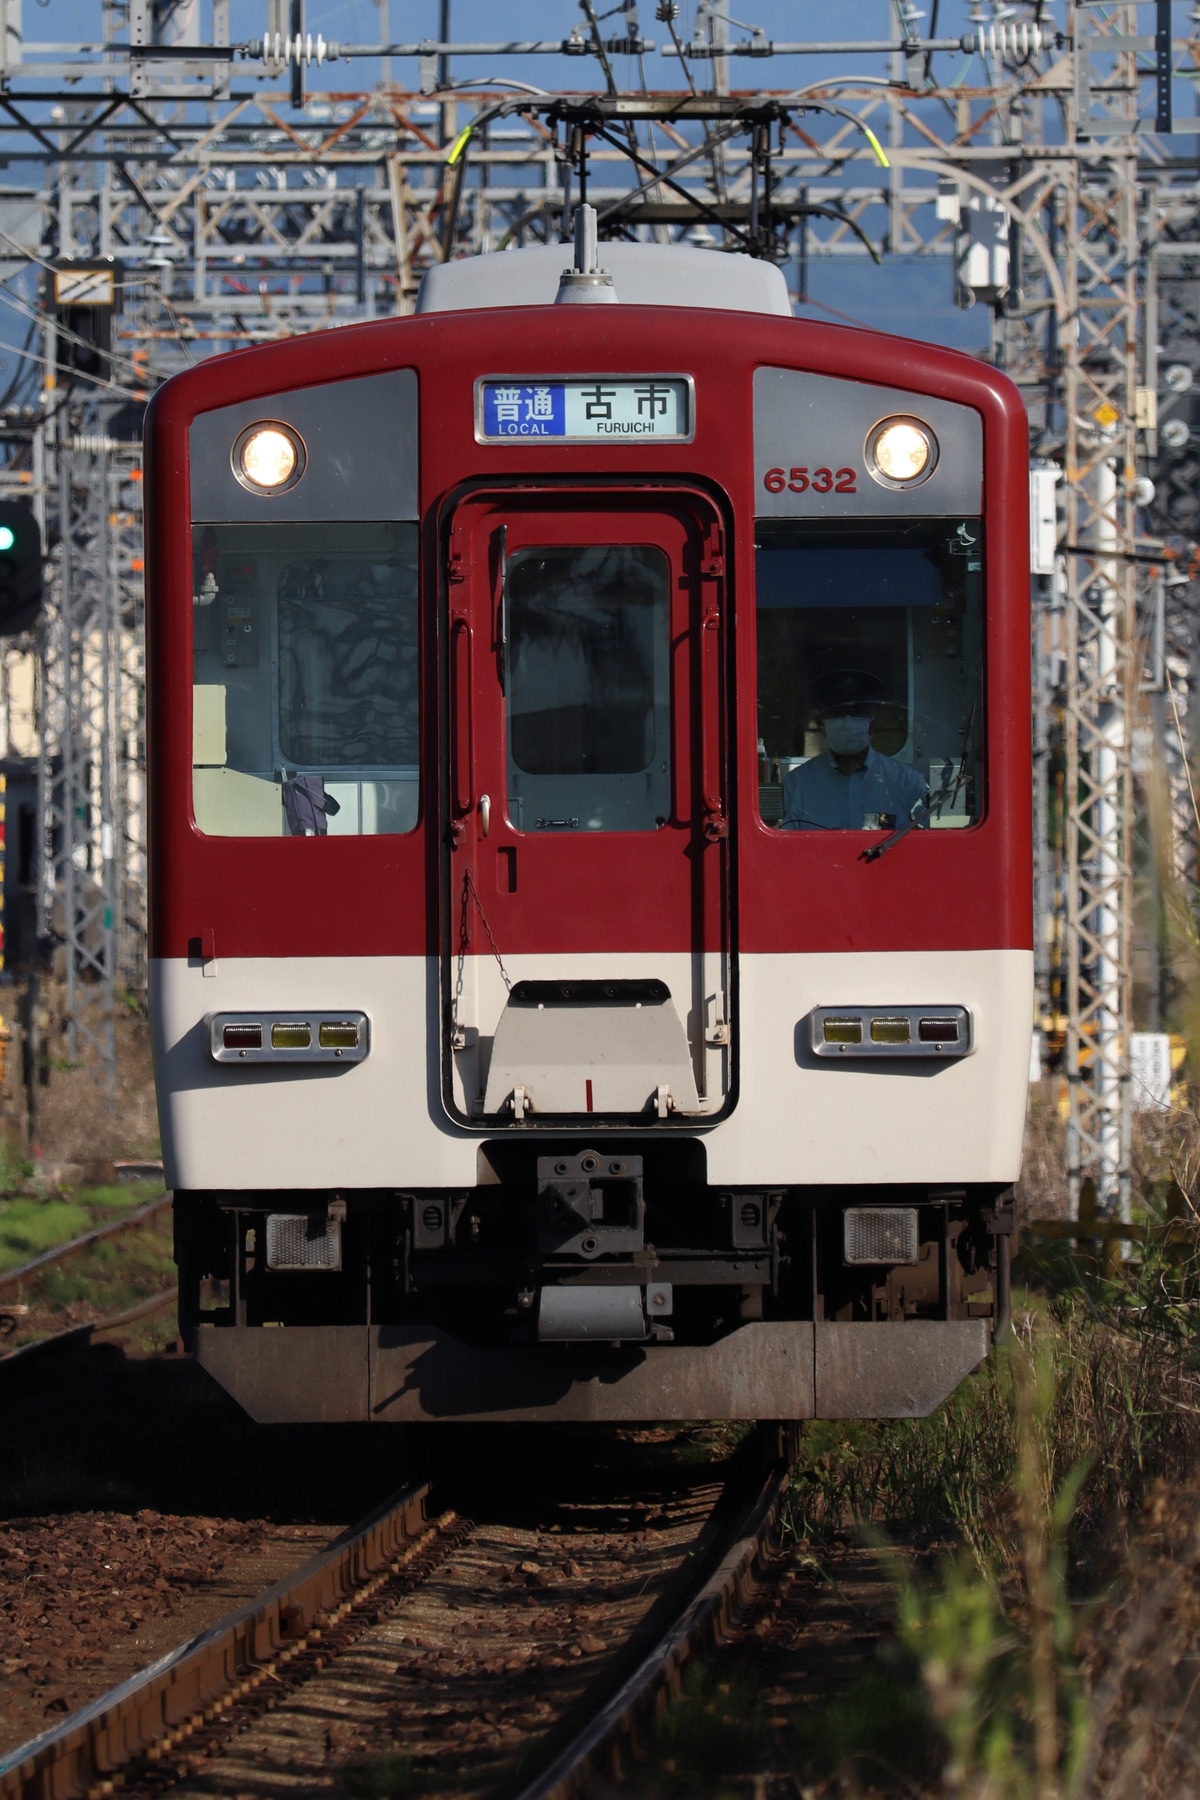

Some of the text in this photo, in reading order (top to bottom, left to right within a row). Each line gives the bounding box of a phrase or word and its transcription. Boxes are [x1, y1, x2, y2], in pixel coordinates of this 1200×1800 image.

[493, 386, 555, 422] 普通
[581, 385, 671, 420] 古市
[498, 423, 549, 435] LOCAL
[597, 422, 655, 433] FURUICHI
[764, 467, 857, 493] 6532
